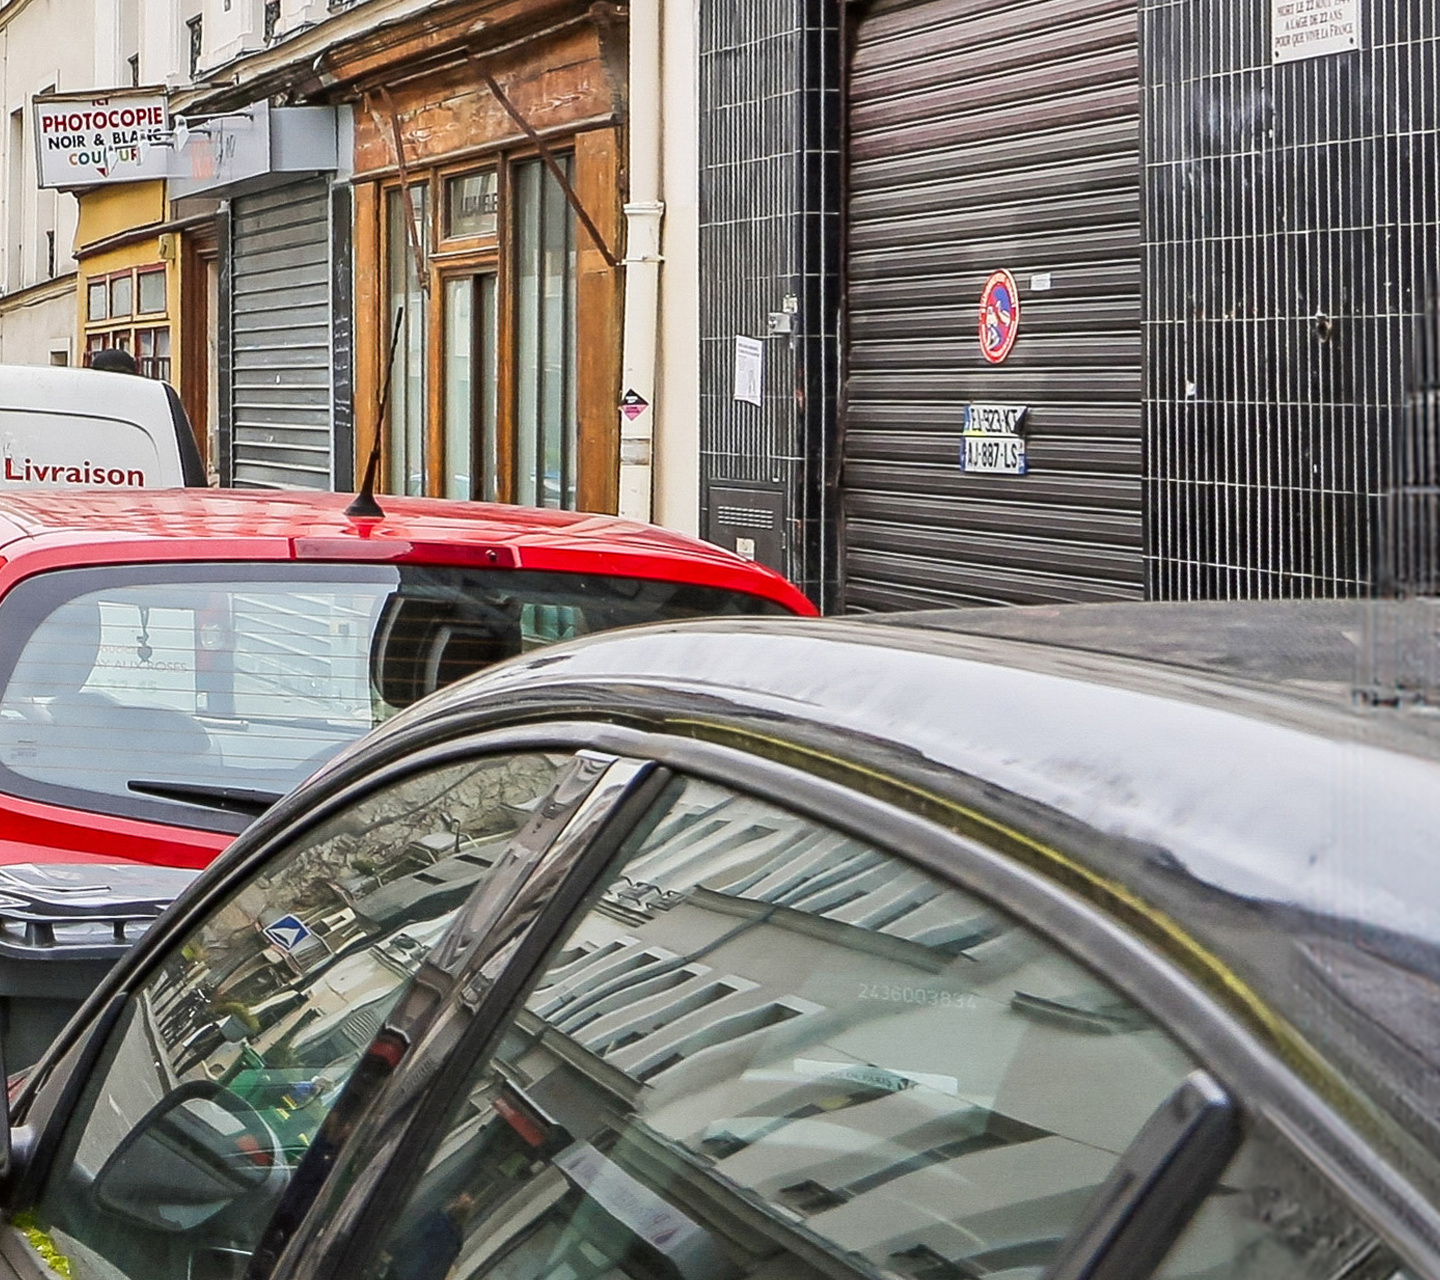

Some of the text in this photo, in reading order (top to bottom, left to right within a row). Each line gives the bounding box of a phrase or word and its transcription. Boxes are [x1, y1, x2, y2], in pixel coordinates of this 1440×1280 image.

[42, 106, 163, 134] PHOTOCOPIE
[48, 134, 87, 151] NOIR
[93, 133, 105, 147] &
[5, 458, 145, 487] Livraison
